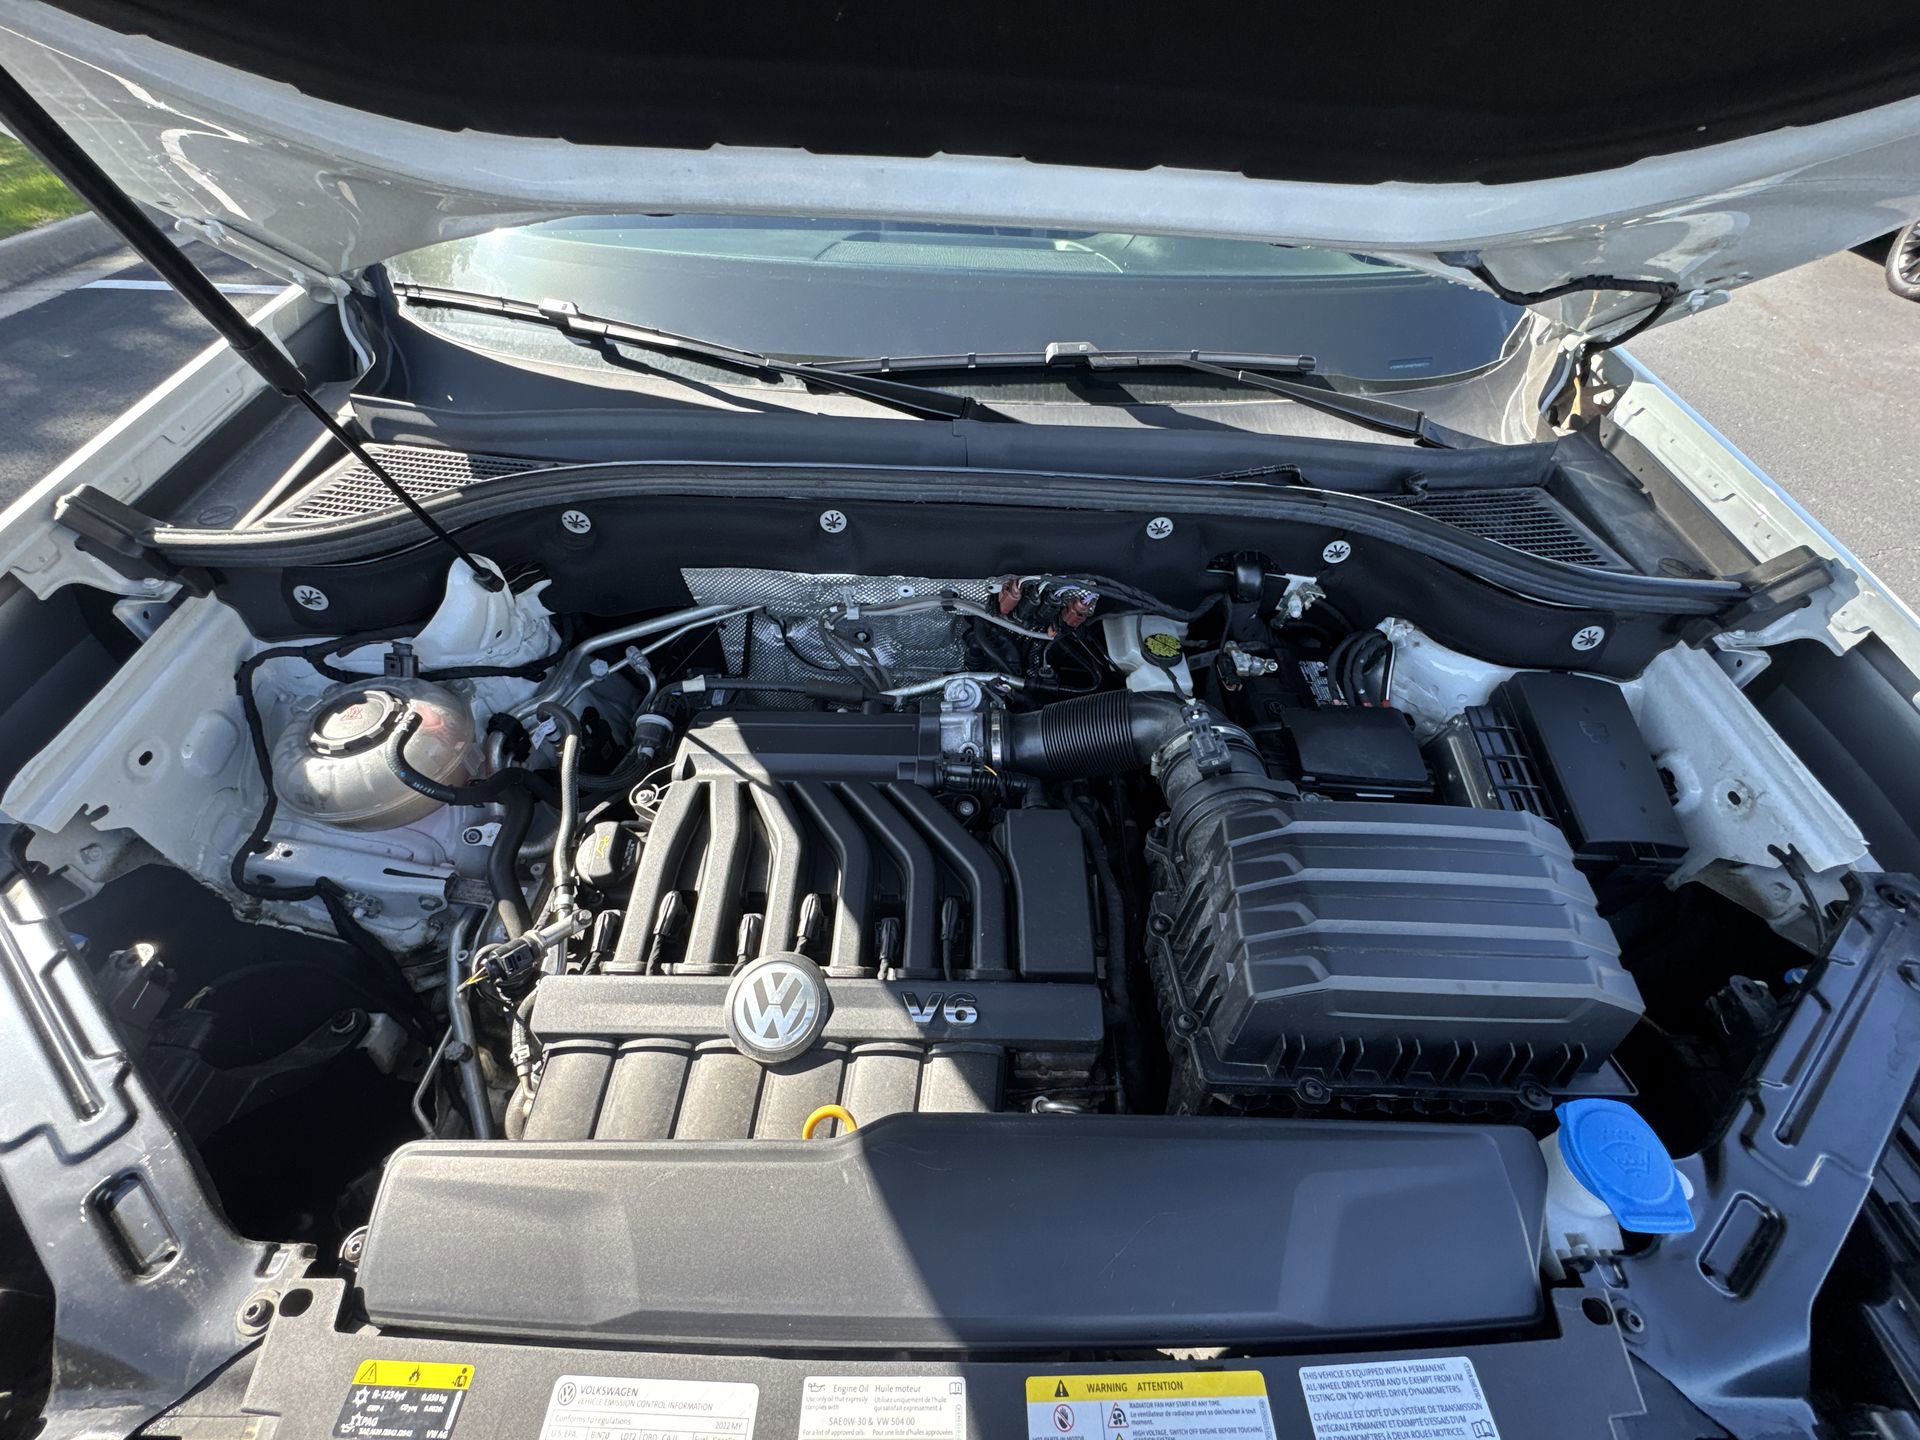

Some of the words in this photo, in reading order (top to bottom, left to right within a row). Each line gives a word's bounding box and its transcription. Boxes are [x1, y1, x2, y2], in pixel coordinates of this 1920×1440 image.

[735, 963, 818, 1048] VW
[902, 991, 978, 1027] V6
[1302, 1371, 1318, 1380] THIS
[1318, 1370, 1344, 1379] VEHICLE
[1345, 1370, 1352, 1378] IS
[1352, 1367, 1384, 1378] EQUIPPED
[1384, 1366, 1402, 1374] WITH
[1408, 1363, 1446, 1373] PERMANENT
[1086, 1382, 1128, 1393] WARNING
[1137, 1381, 1184, 1392] ATTENTION
[1305, 1381, 1342, 1391] ALL-WHEEL
[1342, 1380, 1361, 1389] DRIVE
[1361, 1378, 1386, 1387] SYSTEM
[1387, 1377, 1401, 1386] AND
[1402, 1377, 1409, 1385] IS
[1409, 1375, 1433, 1385] EXEMPT
[1434, 1374, 1452, 1383] FROM
[1452, 1373, 1464, 1381] I/M
[580, 1385, 639, 1397] VOLKSWAGEN
[833, 1384, 858, 1395] Engine
[859, 1383, 869, 1393] Oil
[875, 1384, 894, 1393] Huile
[895, 1385, 921, 1393] moteur
[816, 1396, 827, 1404] only
[845, 1396, 869, 1404] expressly
[893, 1396, 924, 1404] uniquement
[1308, 1392, 1336, 1402] TESTING
[1336, 1391, 1348, 1401] ON
[1347, 1390, 1388, 1400] TWO-WHEEL
[1388, 1388, 1409, 1398] DRIVE
[577, 1397, 602, 1406] VEHICLE
[604, 1399, 635, 1408] EMISSION
[636, 1400, 666, 1409] CONTROL
[668, 1401, 714, 1411] INFORMATION
[1129, 1401, 1153, 1409] RADIATOR
[1313, 1412, 1322, 1421] CE
[1322, 1410, 1352, 1420] VÉHICULE
[1353, 1409, 1365, 1419] EST
[1365, 1407, 1383, 1418] DOTÉ
[1383, 1407, 1400, 1416] D'UN
[1401, 1405, 1427, 1415] SYSTÈME
[1427, 1405, 1437, 1413] DE
[1437, 1402, 1483, 1412] TRANSMISSION
[554, 1414, 586, 1424] Conforms
[868, 1417, 873, 1426] &
[877, 1417, 890, 1426] VW
[891, 1417, 904, 1426] 504
[905, 1416, 915, 1426] 00
[1316, 1422, 1349, 1433] INTÉGRALE
[1350, 1420, 1388, 1431] PERMANENT
[1388, 1419, 1396, 1428] ET
[1396, 1416, 1424, 1428] EXEMPTÉ
[1424, 1416, 1450, 1426] D'ESSAIS
[715, 1421, 731, 1430] 2022
[731, 1422, 743, 1430] MY
[1198, 1427, 1217, 1435] ENGINE
[426, 1430, 438, 1439] VW
[437, 1430, 449, 1439] AG
[831, 1429, 855, 1437] approved
[1392, 1430, 1410, 1440] DEUX
[1411, 1429, 1432, 1438] ROUES
